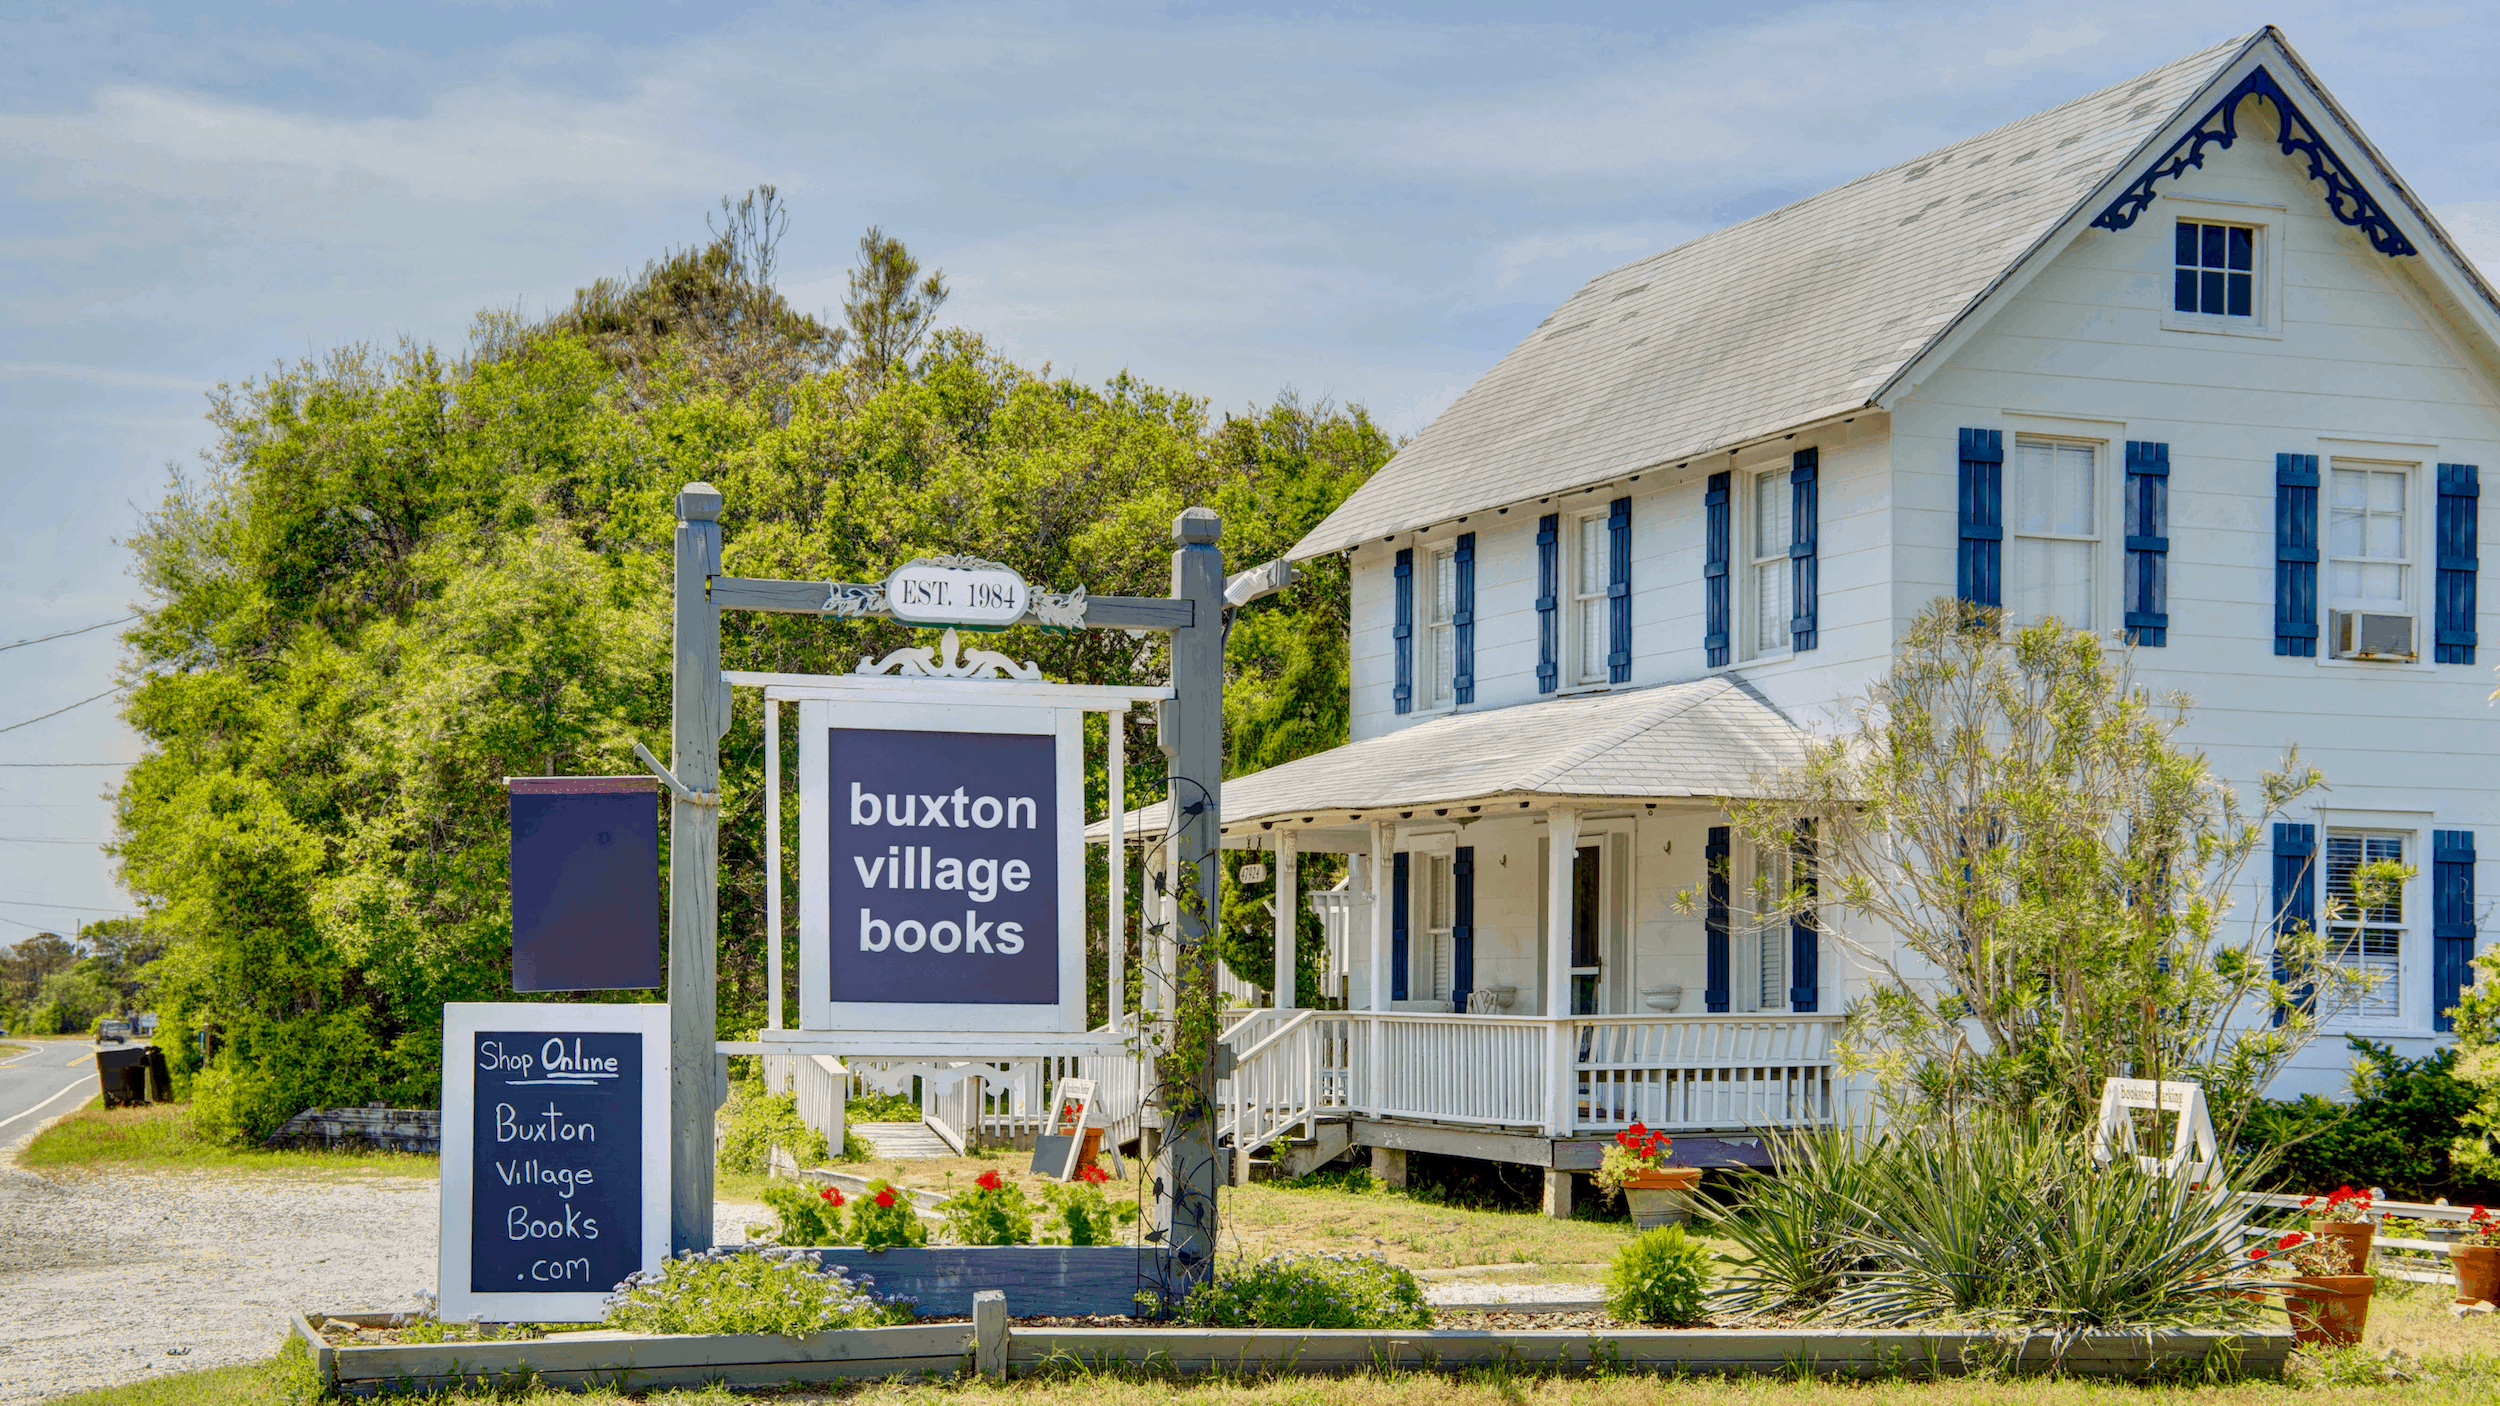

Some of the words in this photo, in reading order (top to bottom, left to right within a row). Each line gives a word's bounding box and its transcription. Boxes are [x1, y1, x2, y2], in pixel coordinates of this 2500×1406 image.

[902, 579, 952, 607] EST.
[967, 582, 1015, 610] 1984
[850, 781, 1037, 829] buxton
[853, 845, 1031, 903] village
[859, 908, 1025, 955] books
[479, 1040, 533, 1077] Shop
[541, 1037, 618, 1073] Online
[2121, 1084, 2155, 1102] Bookstore
[2160, 1087, 2183, 1108] arking
[495, 1101, 595, 1143] Buxton
[495, 1159, 594, 1199] Village
[507, 1203, 599, 1241] Books
[517, 1257, 590, 1283] .com
